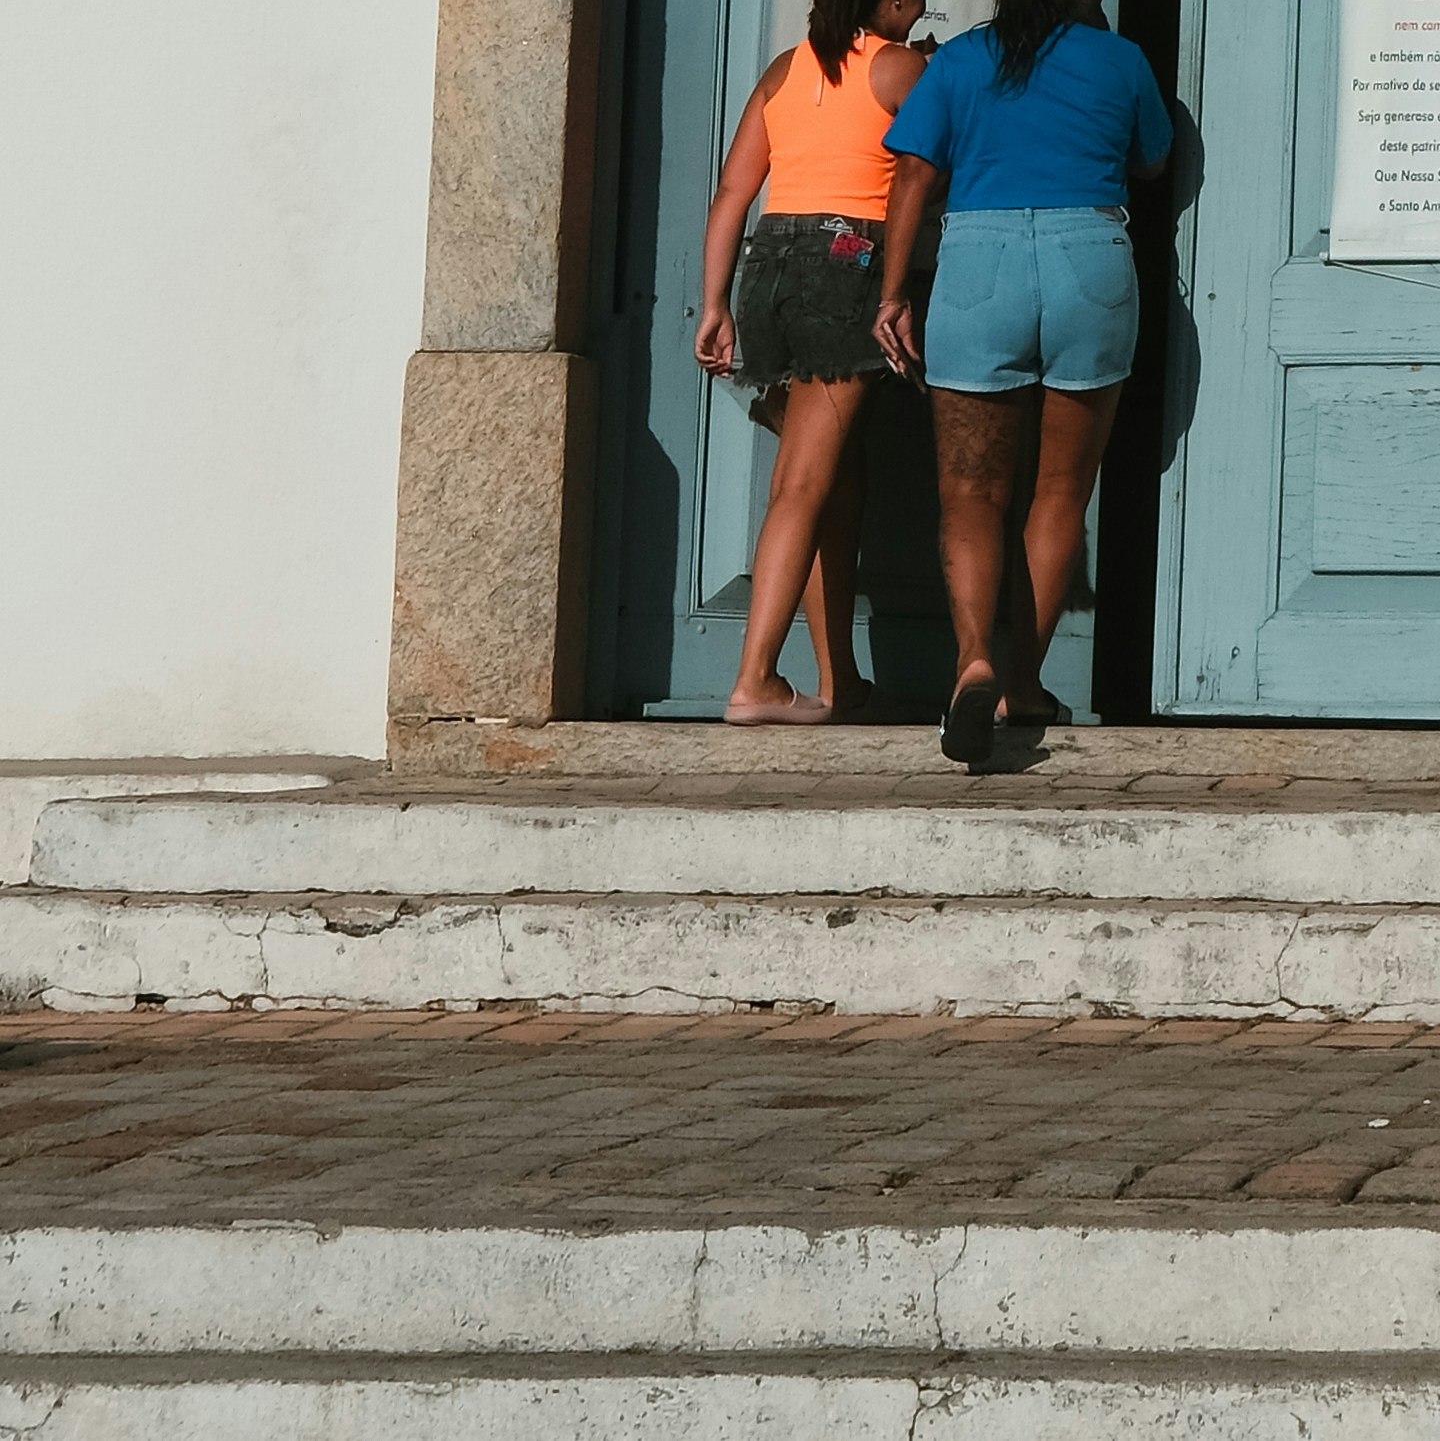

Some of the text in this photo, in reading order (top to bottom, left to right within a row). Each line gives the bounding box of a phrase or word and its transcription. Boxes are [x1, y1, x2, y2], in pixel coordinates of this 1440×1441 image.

[1395, 22, 1418, 30] nem
[1370, 54, 1376, 62] e
[1380, 49, 1423, 62] também
[1353, 79, 1369, 91] Por
[1373, 78, 1409, 90] motivo
[1413, 79, 1425, 90] de
[1358, 110, 1380, 125] Seja
[1384, 113, 1434, 124] generoso
[1380, 139, 1408, 151] deste
[1375, 170, 1397, 181] Que
[1401, 170, 1434, 181] Nossa
[1379, 203, 1385, 211] e
[1389, 199, 1419, 211] Santo
